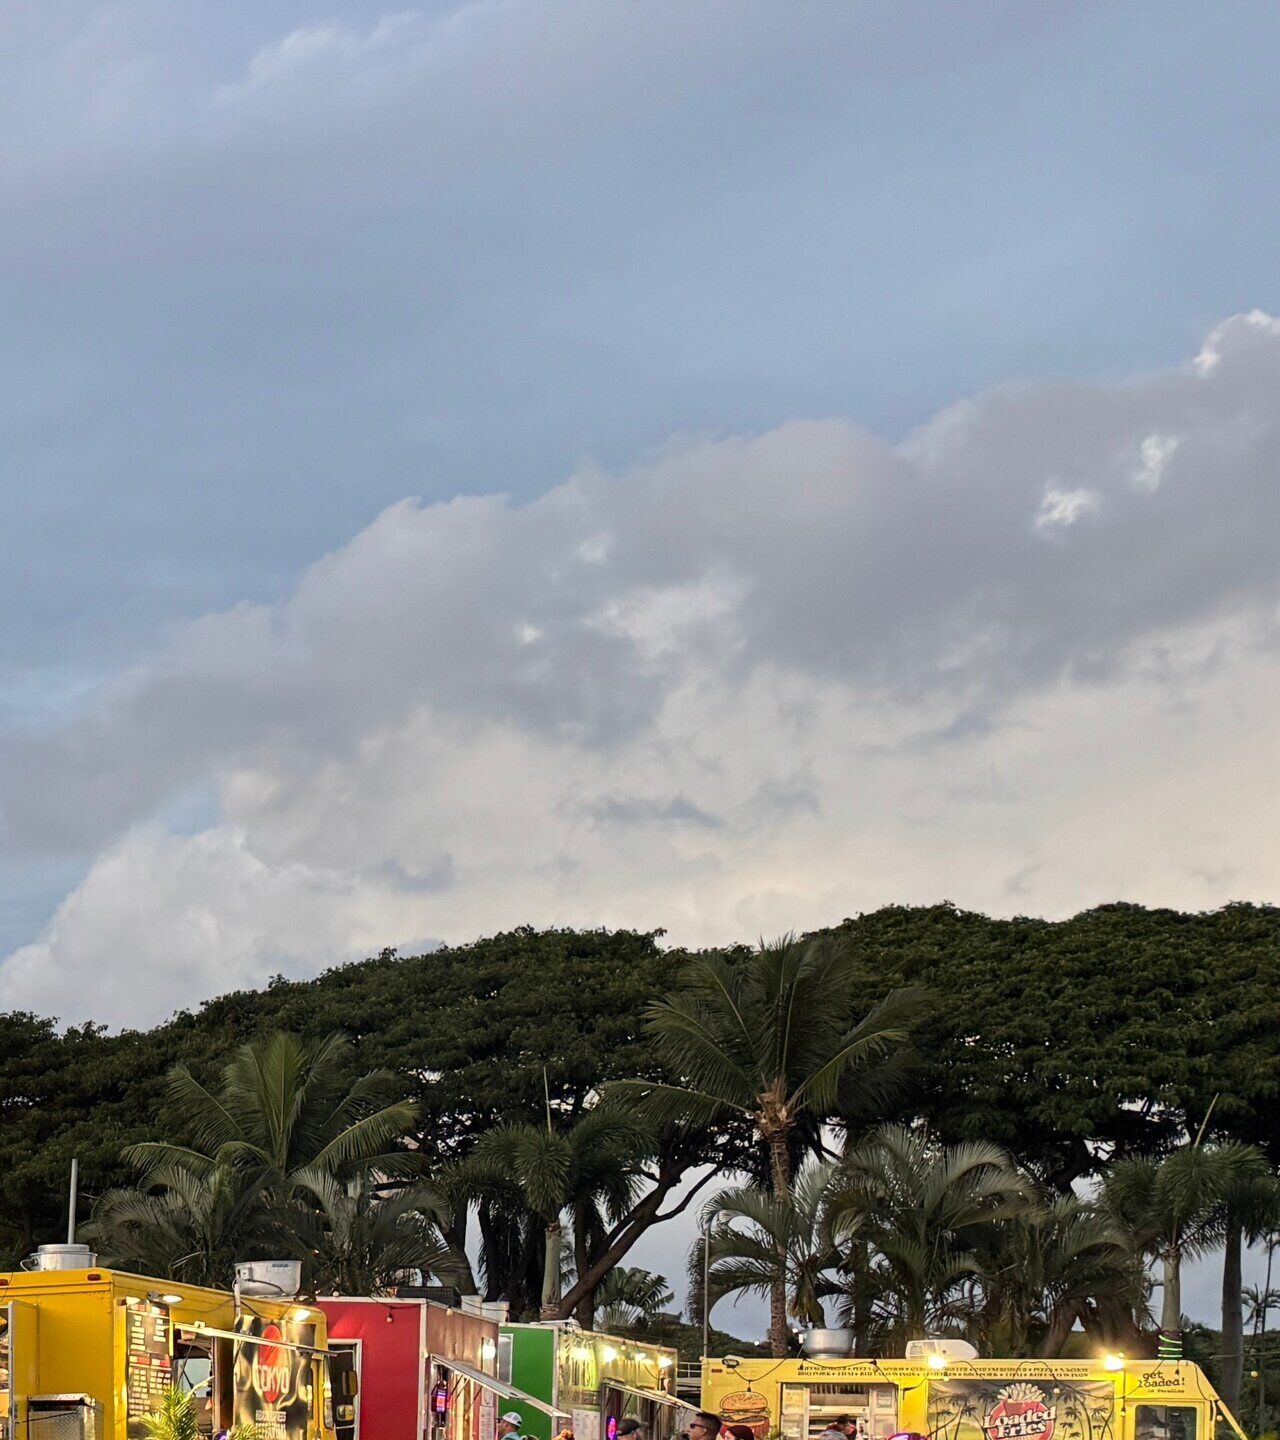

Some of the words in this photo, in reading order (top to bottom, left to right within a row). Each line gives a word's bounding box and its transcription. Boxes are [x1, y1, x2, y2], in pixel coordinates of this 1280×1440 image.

[1143, 1371, 1163, 1380] get
[1138, 1378, 1185, 1387] loaded!
[983, 1406, 1056, 1428] Loaded
[997, 1421, 1046, 1439] Fries
